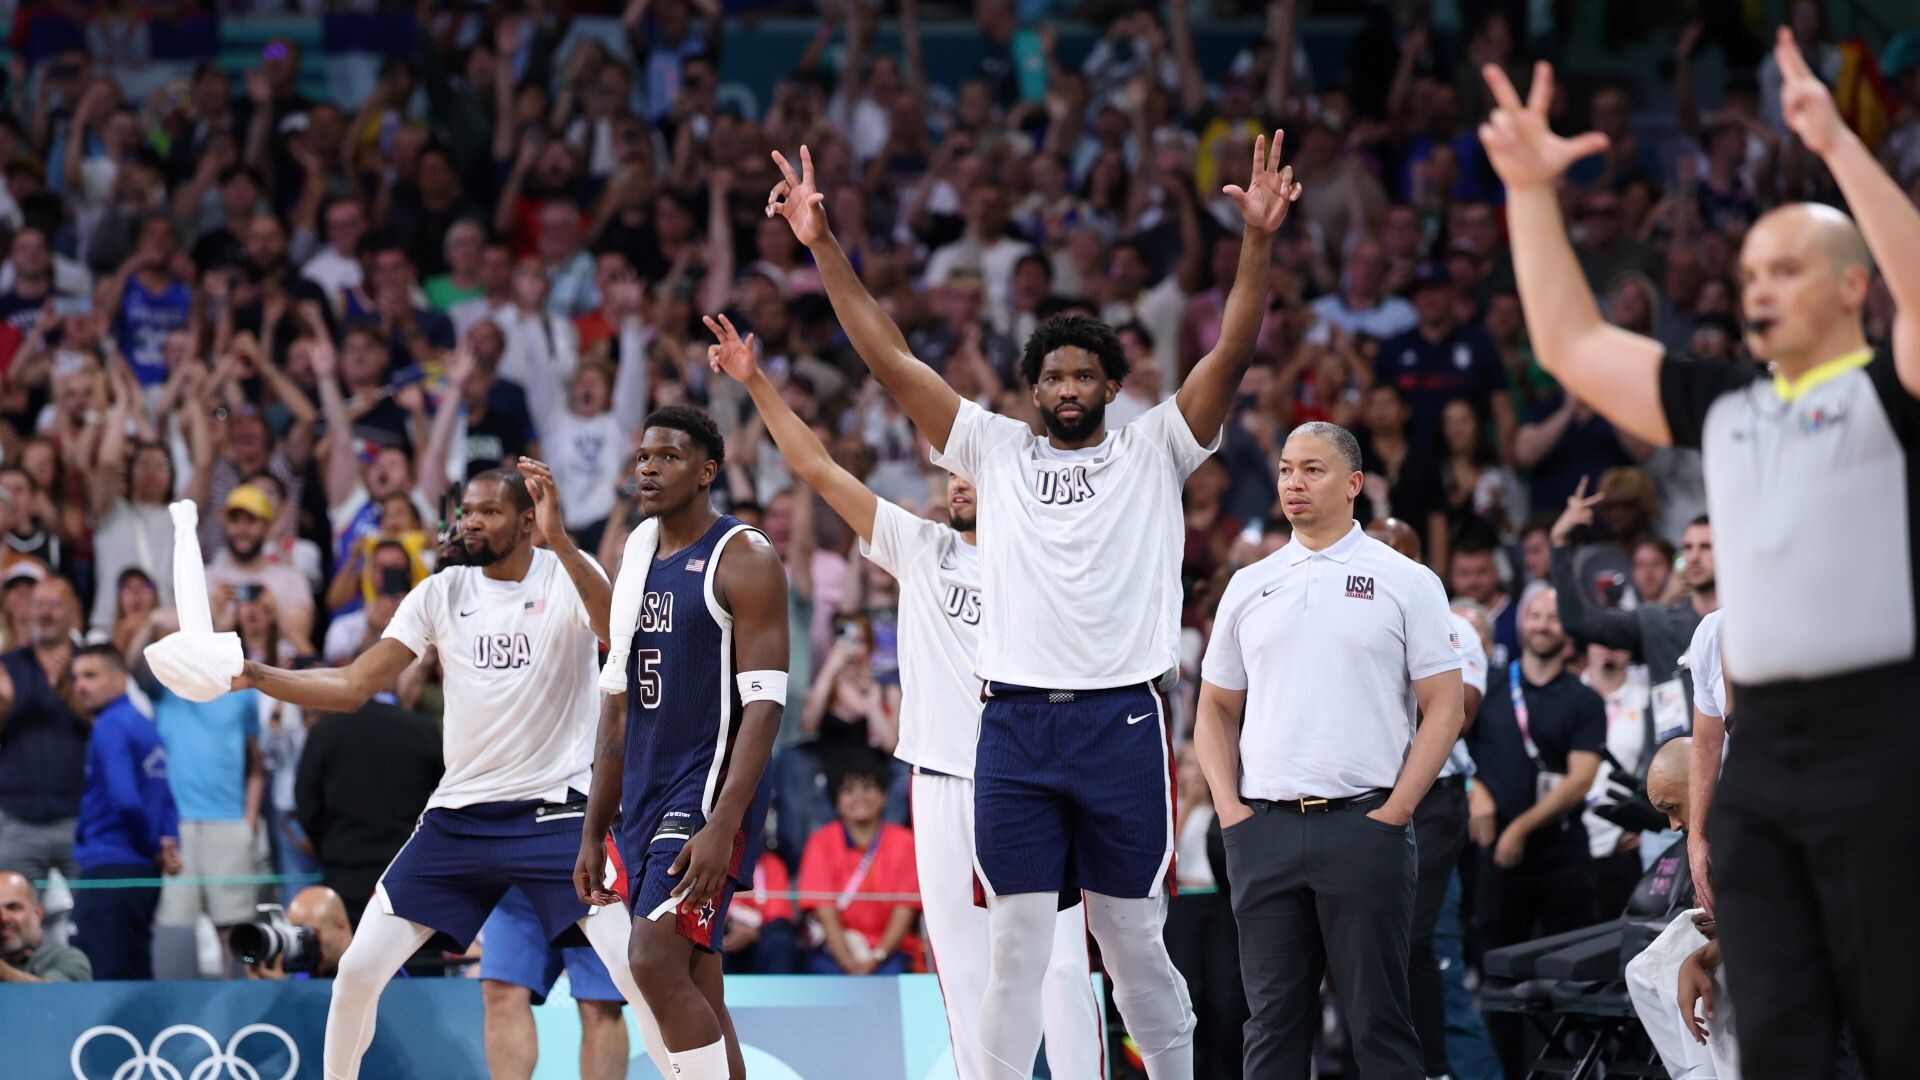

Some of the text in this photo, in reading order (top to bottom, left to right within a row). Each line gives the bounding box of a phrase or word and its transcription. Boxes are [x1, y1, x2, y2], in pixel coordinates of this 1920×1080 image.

[1036, 466, 1095, 505] USA
[944, 584, 982, 626] US
[1346, 575, 1374, 596] USA
[636, 591, 674, 633] SA
[474, 633, 530, 669] USA
[638, 649, 662, 709] 5
[751, 681, 763, 692] 5
